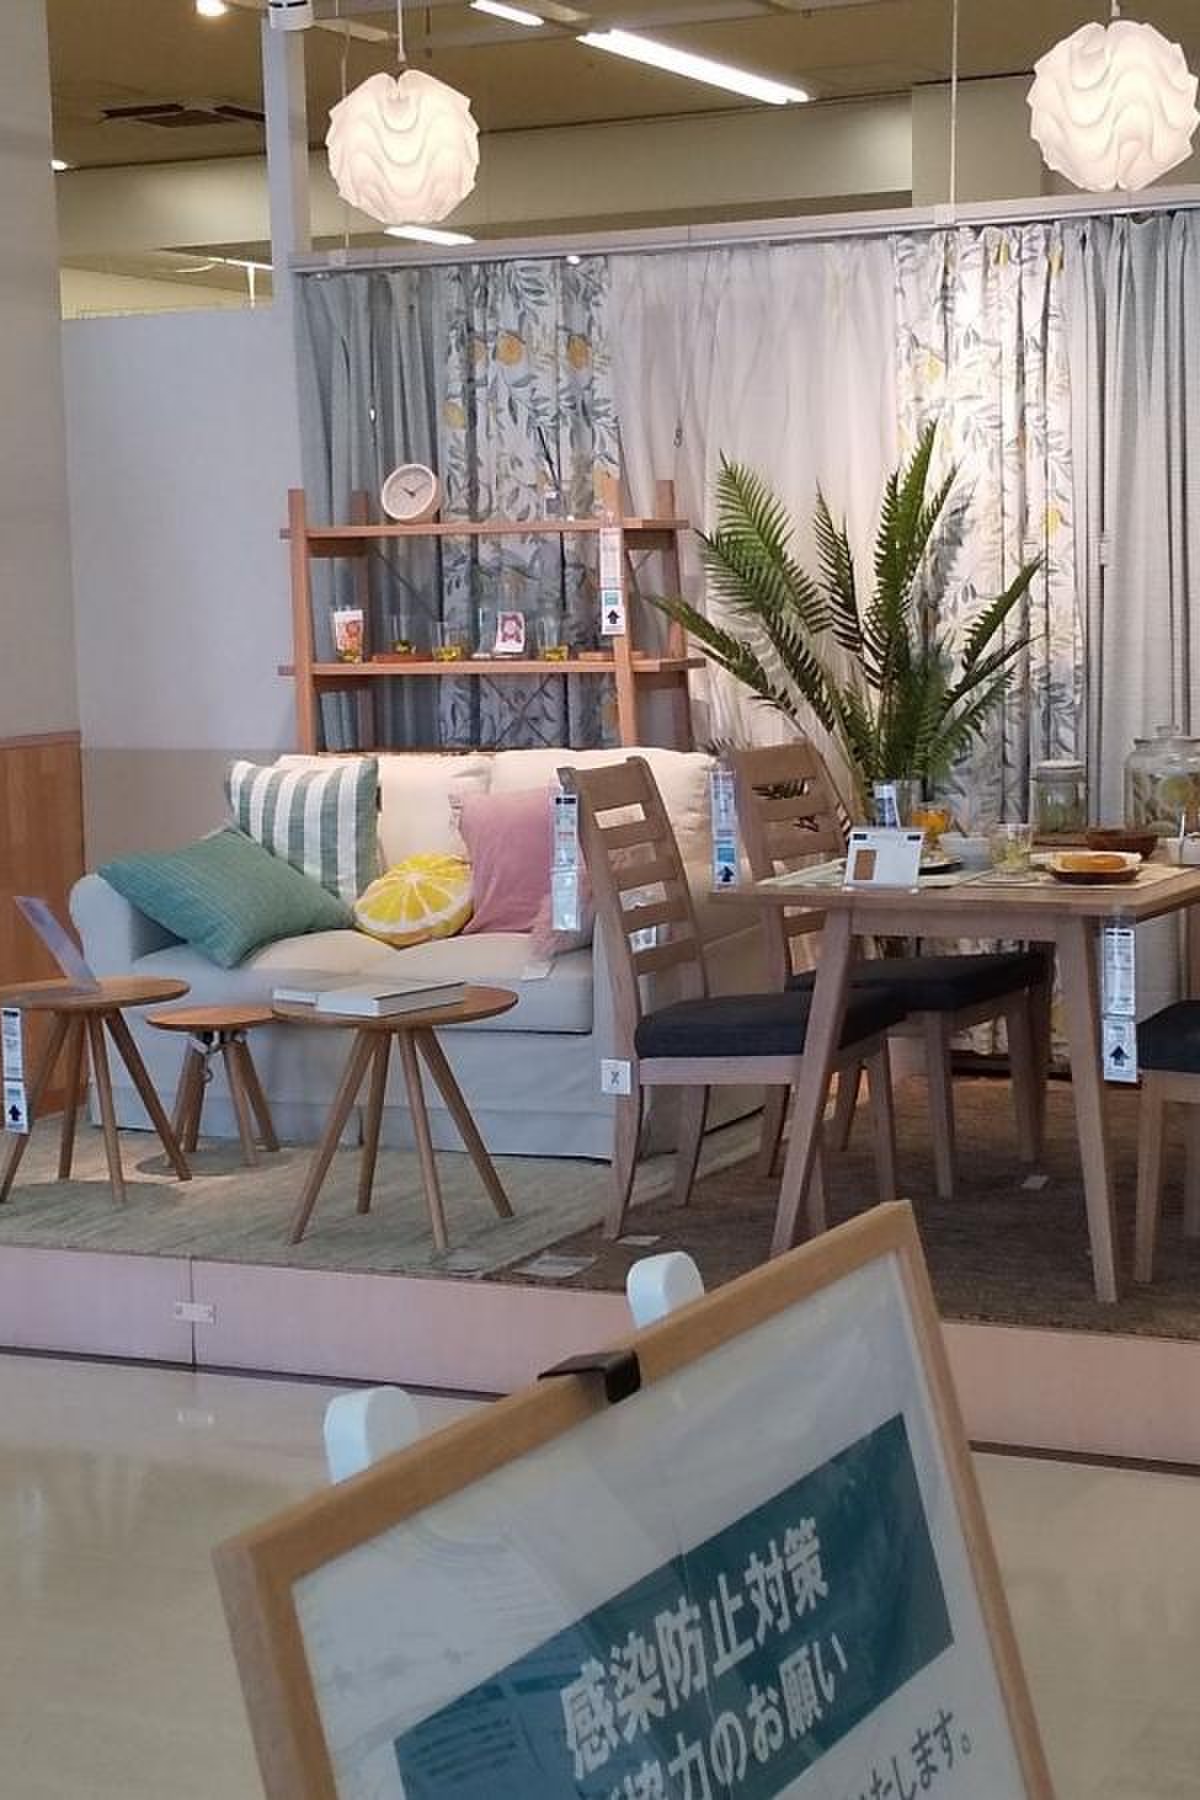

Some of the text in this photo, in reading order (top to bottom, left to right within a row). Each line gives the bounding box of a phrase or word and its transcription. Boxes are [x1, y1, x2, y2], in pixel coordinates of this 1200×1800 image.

[561, 1517, 828, 1780] 感染防止対策
[859, 1708, 972, 1800] たします。
